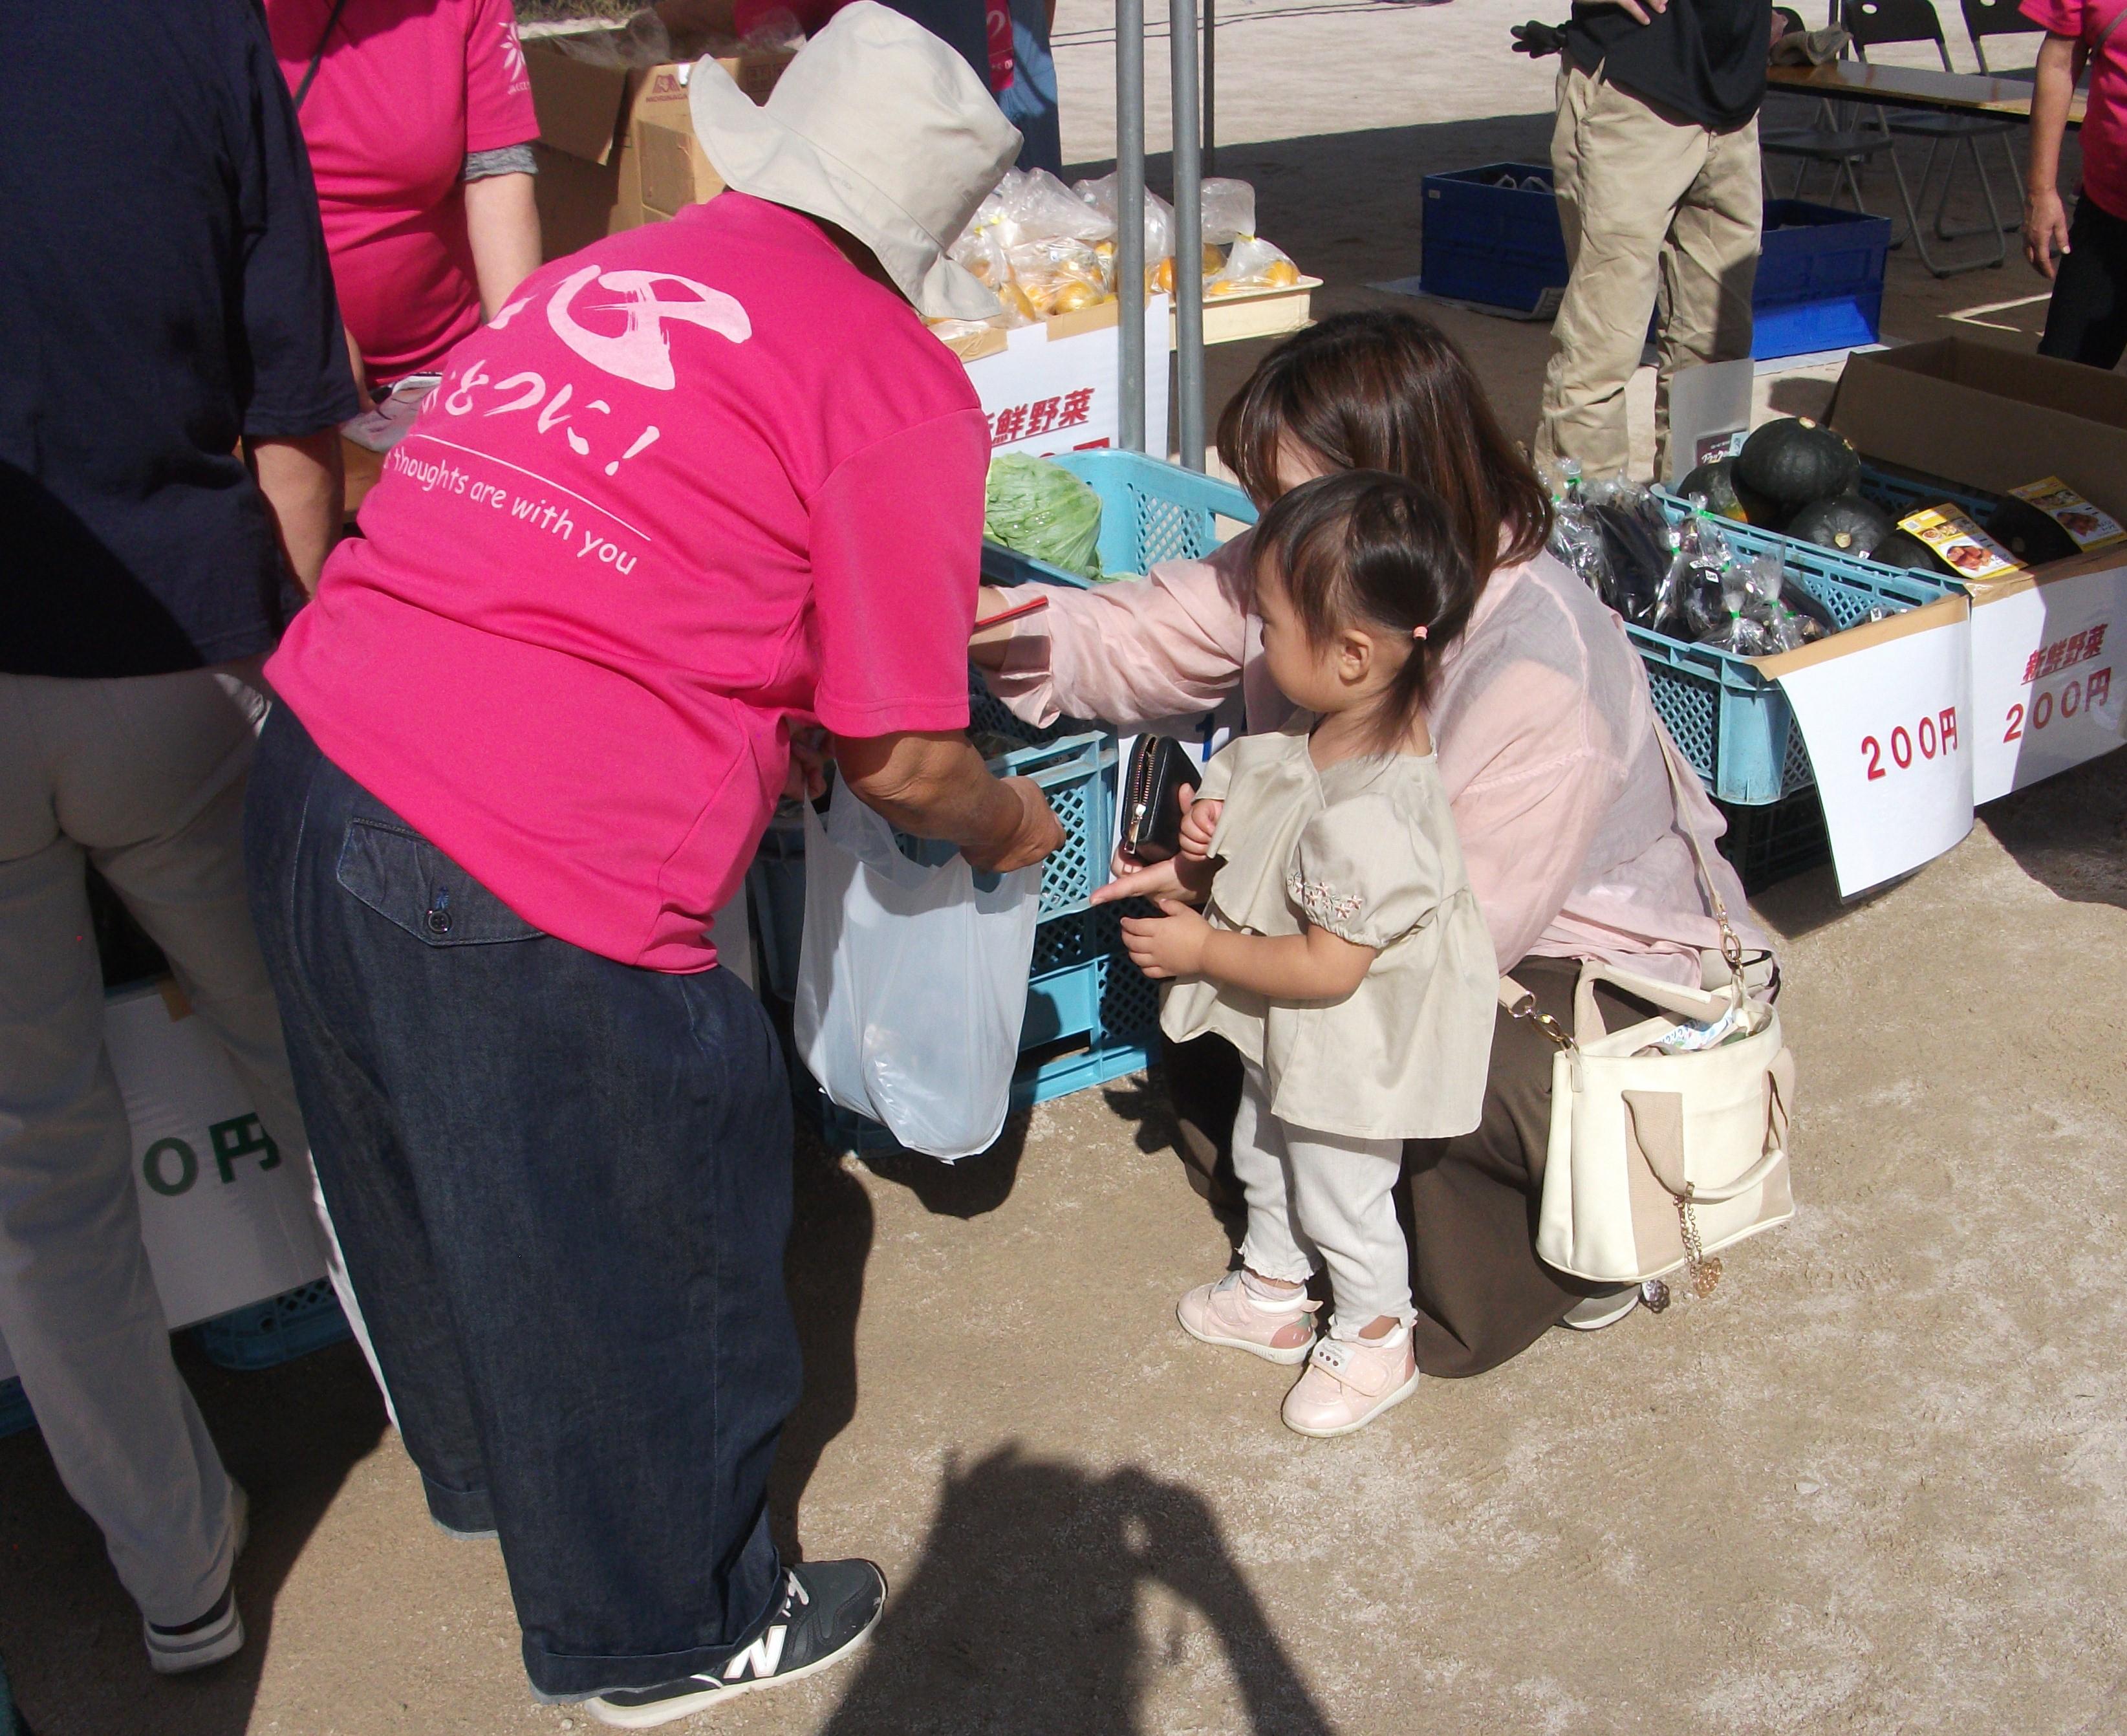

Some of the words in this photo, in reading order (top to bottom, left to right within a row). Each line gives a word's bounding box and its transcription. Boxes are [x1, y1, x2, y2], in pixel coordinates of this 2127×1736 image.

[394, 446, 470, 494] thoughts
[470, 481, 508, 510] are
[512, 499, 573, 541] with
[577, 530, 638, 576] you
[2022, 624, 2108, 682] 新鮮野菜
[2003, 667, 2111, 743] 200円
[1861, 706, 1959, 781] 200円
